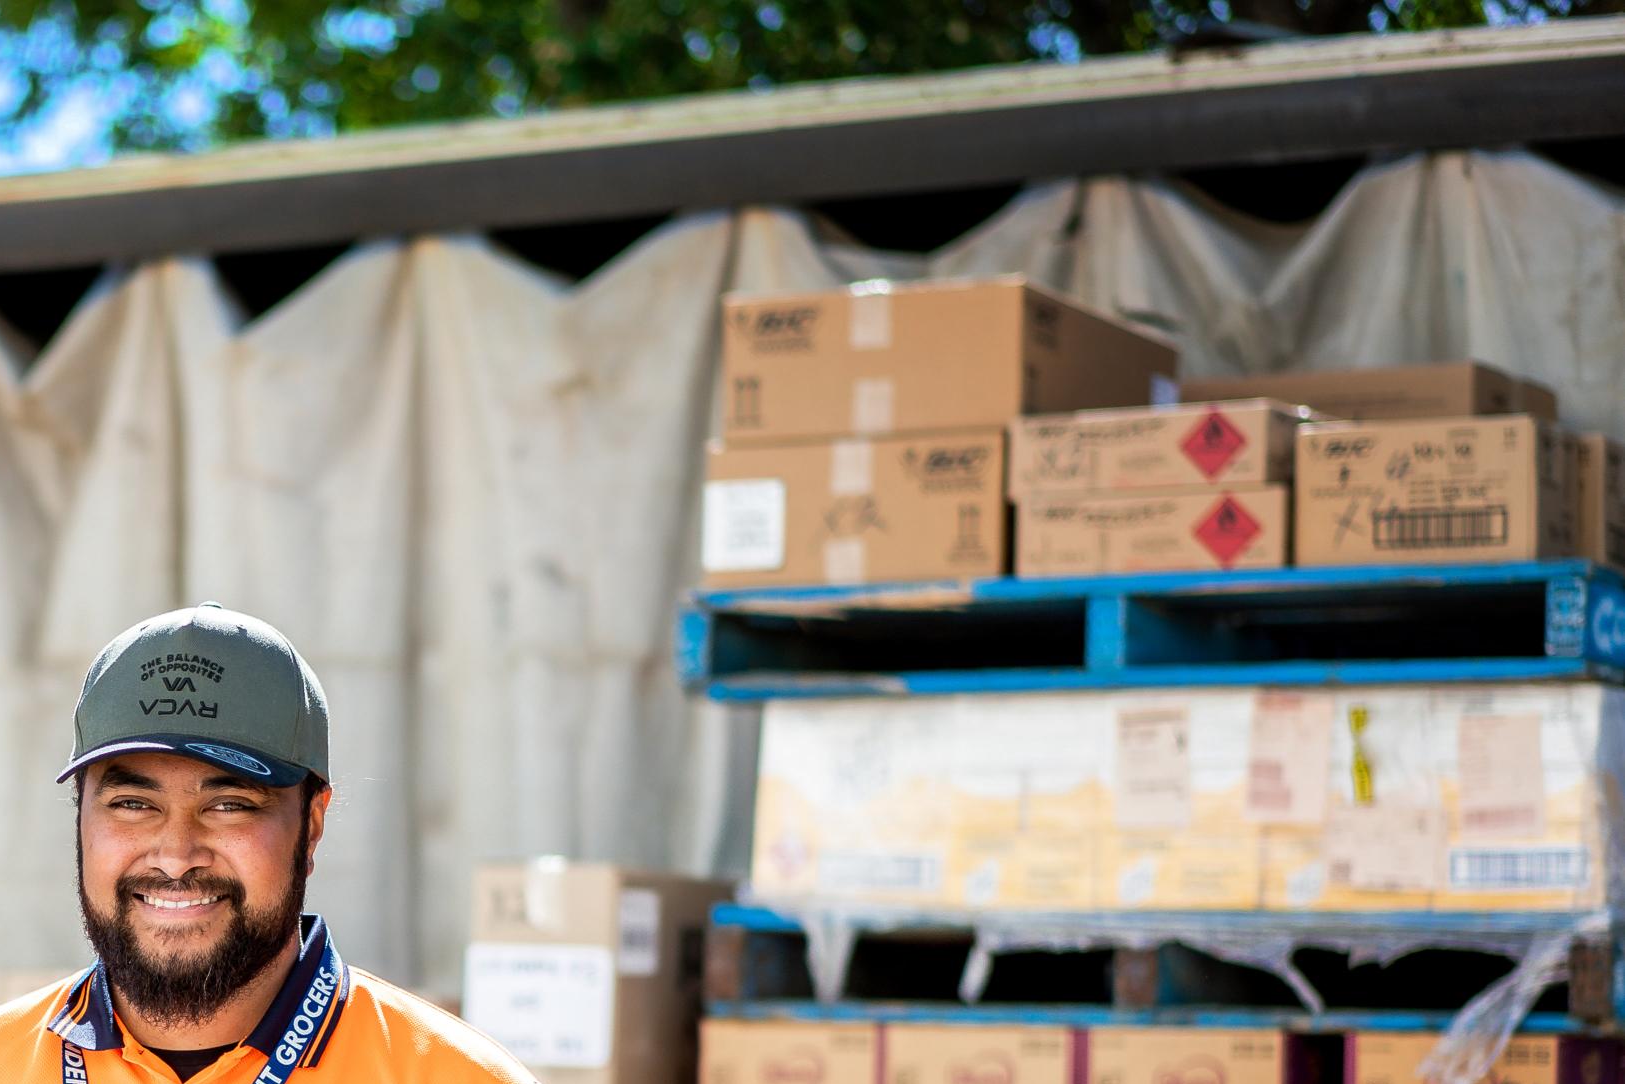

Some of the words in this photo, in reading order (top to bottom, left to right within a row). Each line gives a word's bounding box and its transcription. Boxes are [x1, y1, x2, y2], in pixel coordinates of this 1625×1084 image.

[140, 657, 162, 671] THE
[167, 654, 225, 674] BALANCE
[141, 669, 156, 681] OF
[158, 663, 222, 683] OPPOSITES
[138, 699, 218, 718] RVCA
[275, 967, 337, 1066] GROCERS
